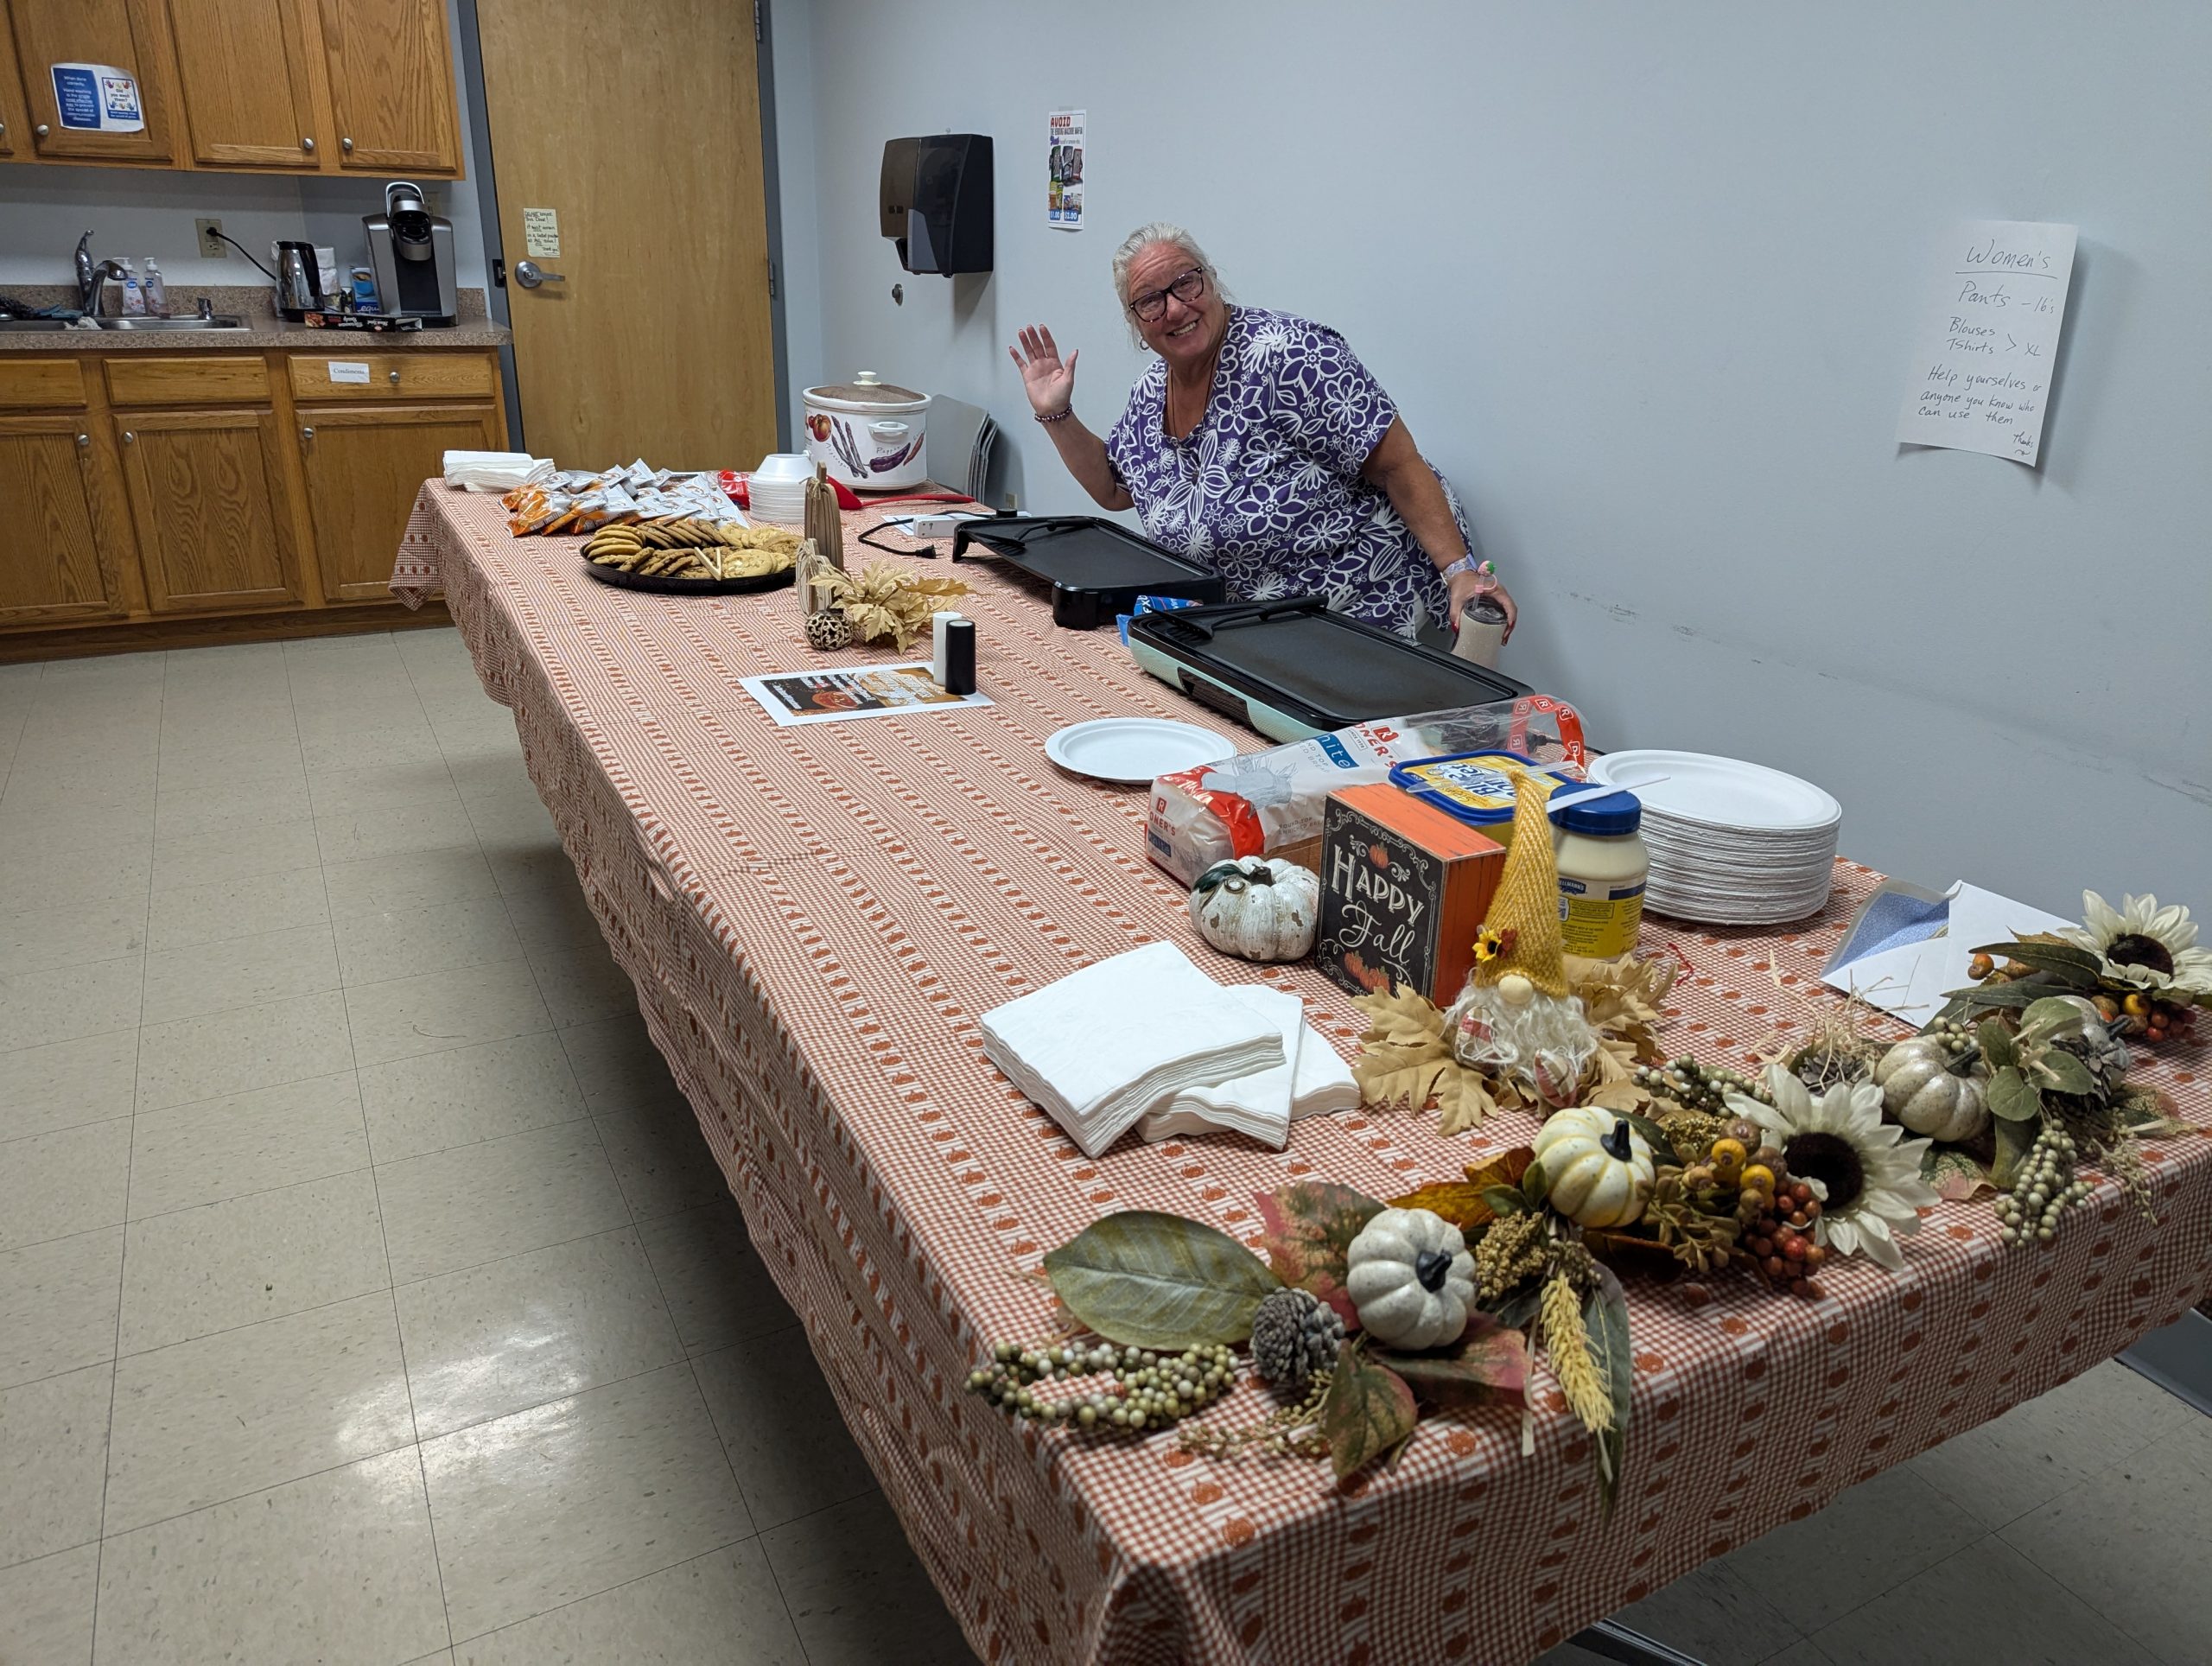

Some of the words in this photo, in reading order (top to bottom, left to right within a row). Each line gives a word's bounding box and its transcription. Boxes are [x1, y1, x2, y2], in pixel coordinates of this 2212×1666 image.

[1051, 117, 1071, 127] AVOID
[1967, 238, 2050, 269] Women's
[1959, 280, 2011, 308] Pants
[1949, 316, 1995, 336] Blouses
[2024, 342, 2040, 356] XL
[1928, 364, 1958, 386] Help
[1964, 372, 2025, 391] yourselves
[1920, 391, 1961, 406] anyone
[1964, 397, 1984, 410] you
[2018, 400, 2034, 411] who
[1948, 410, 1970, 419] use
[1986, 411, 2012, 425] them
[1316, 754, 1329, 766] TOP
[1279, 819, 1299, 829] ROUND
[1332, 844, 1424, 926] HAPPY
[1339, 900, 1414, 964] Fall
